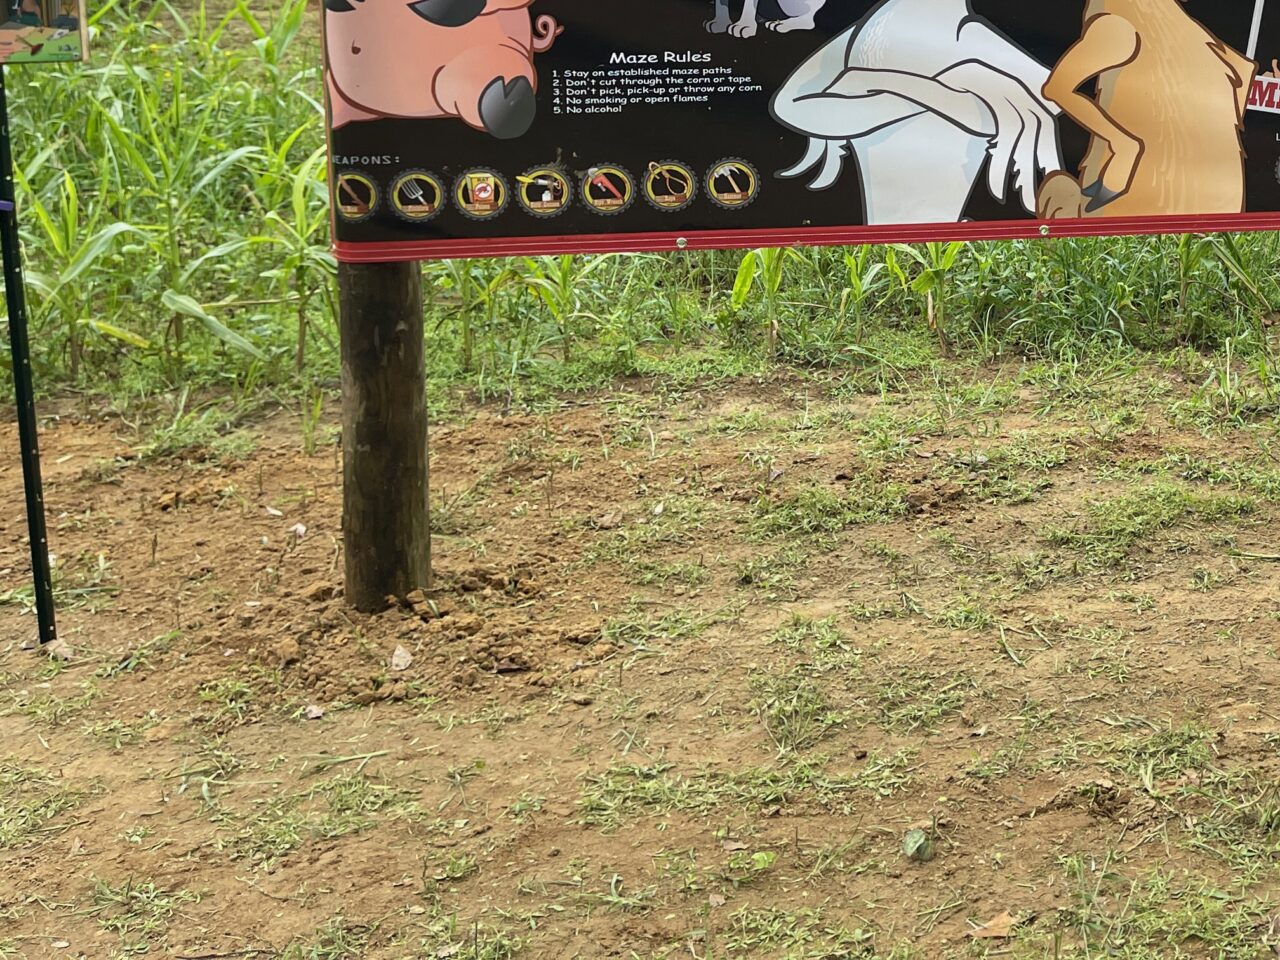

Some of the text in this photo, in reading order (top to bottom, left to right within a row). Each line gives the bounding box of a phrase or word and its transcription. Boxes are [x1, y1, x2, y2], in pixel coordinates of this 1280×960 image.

[609, 51, 711, 64] Maze Rules
[564, 70, 589, 78] Stay
[607, 68, 669, 76] established
[702, 67, 732, 76] paths
[552, 79, 562, 87] 2.
[620, 77, 662, 86] through
[728, 76, 752, 84] tape
[553, 88, 562, 96] 3.
[600, 87, 624, 96] pick,
[627, 86, 665, 96] pick-up
[683, 85, 715, 93] throw
[553, 97, 563, 105] 4.
[585, 96, 627, 105] smoking
[645, 96, 670, 104] open
[673, 94, 708, 102] flames
[585, 105, 622, 113] alcohol
